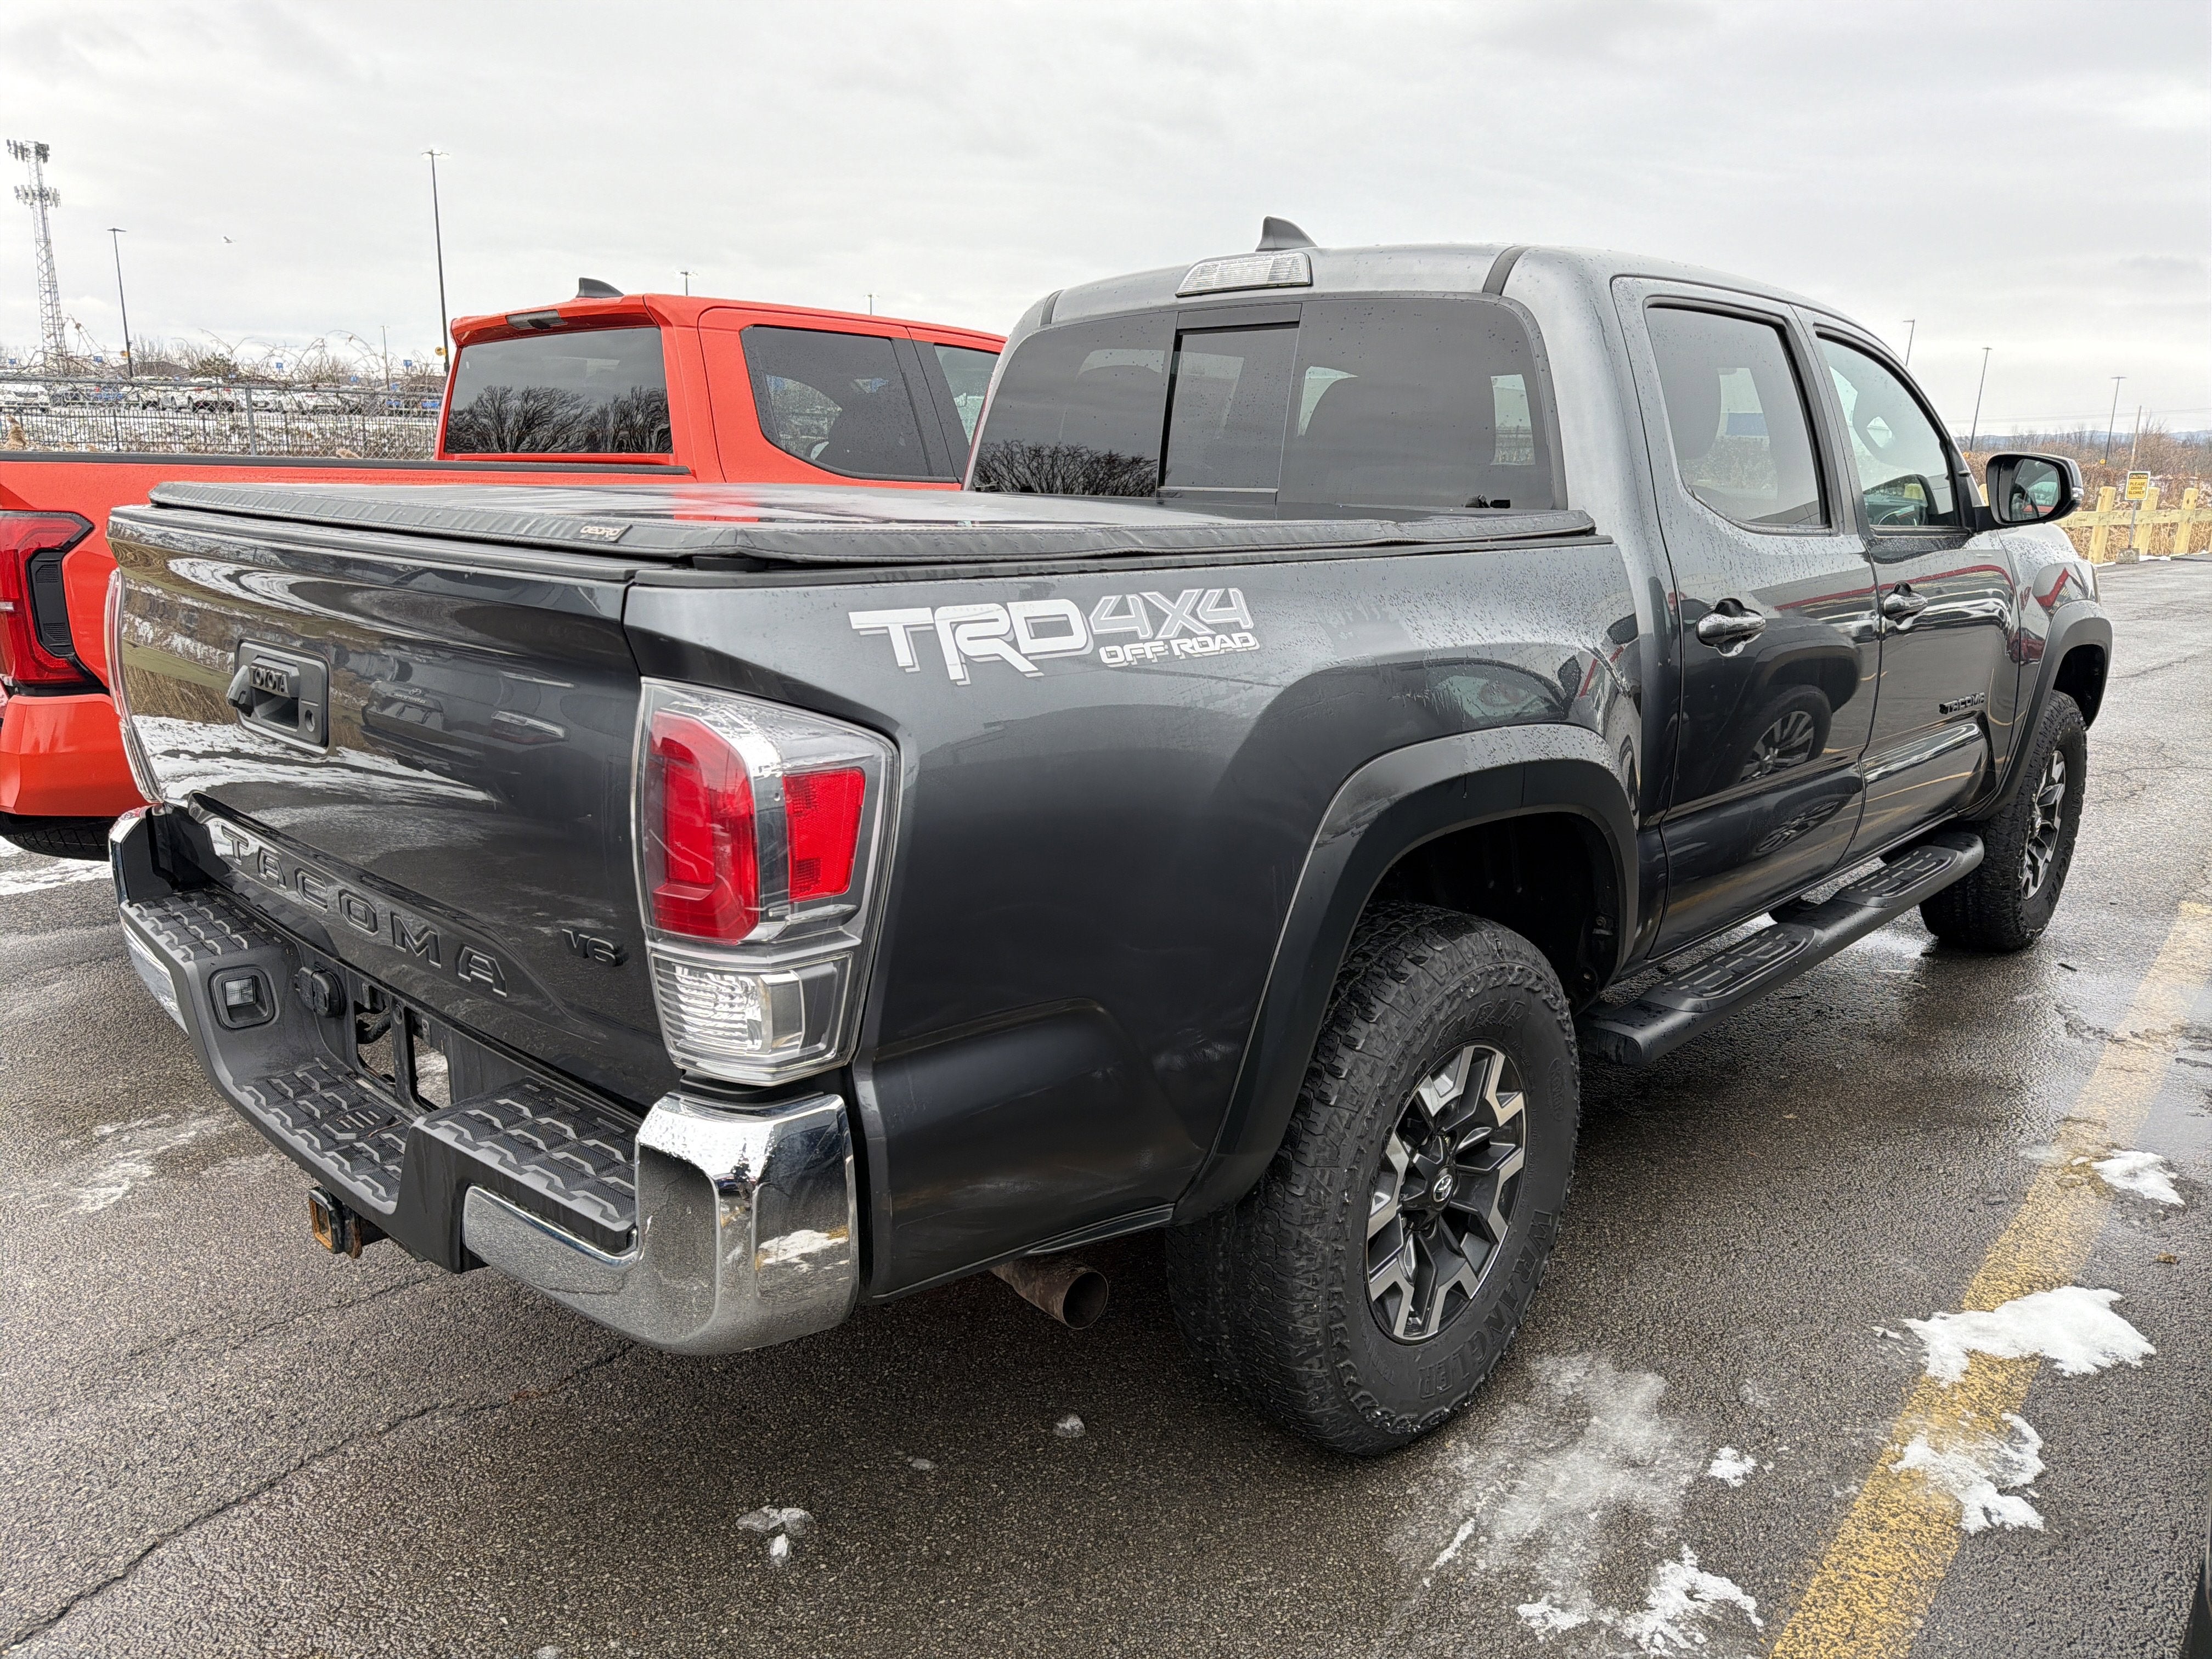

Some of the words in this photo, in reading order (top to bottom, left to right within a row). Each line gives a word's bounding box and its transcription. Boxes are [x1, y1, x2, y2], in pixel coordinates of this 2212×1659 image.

[848, 598, 1093, 686] TRD
[1099, 640, 1167, 667] OFF
[1170, 632, 1260, 657] ROAD
[250, 665, 289, 694] TOYOTA
[1940, 692, 1985, 714] TACOMA
[220, 823, 508, 998] TACOMA
[561, 928, 621, 967] V6
[1418, 1209, 1553, 1400] WRANGLER
